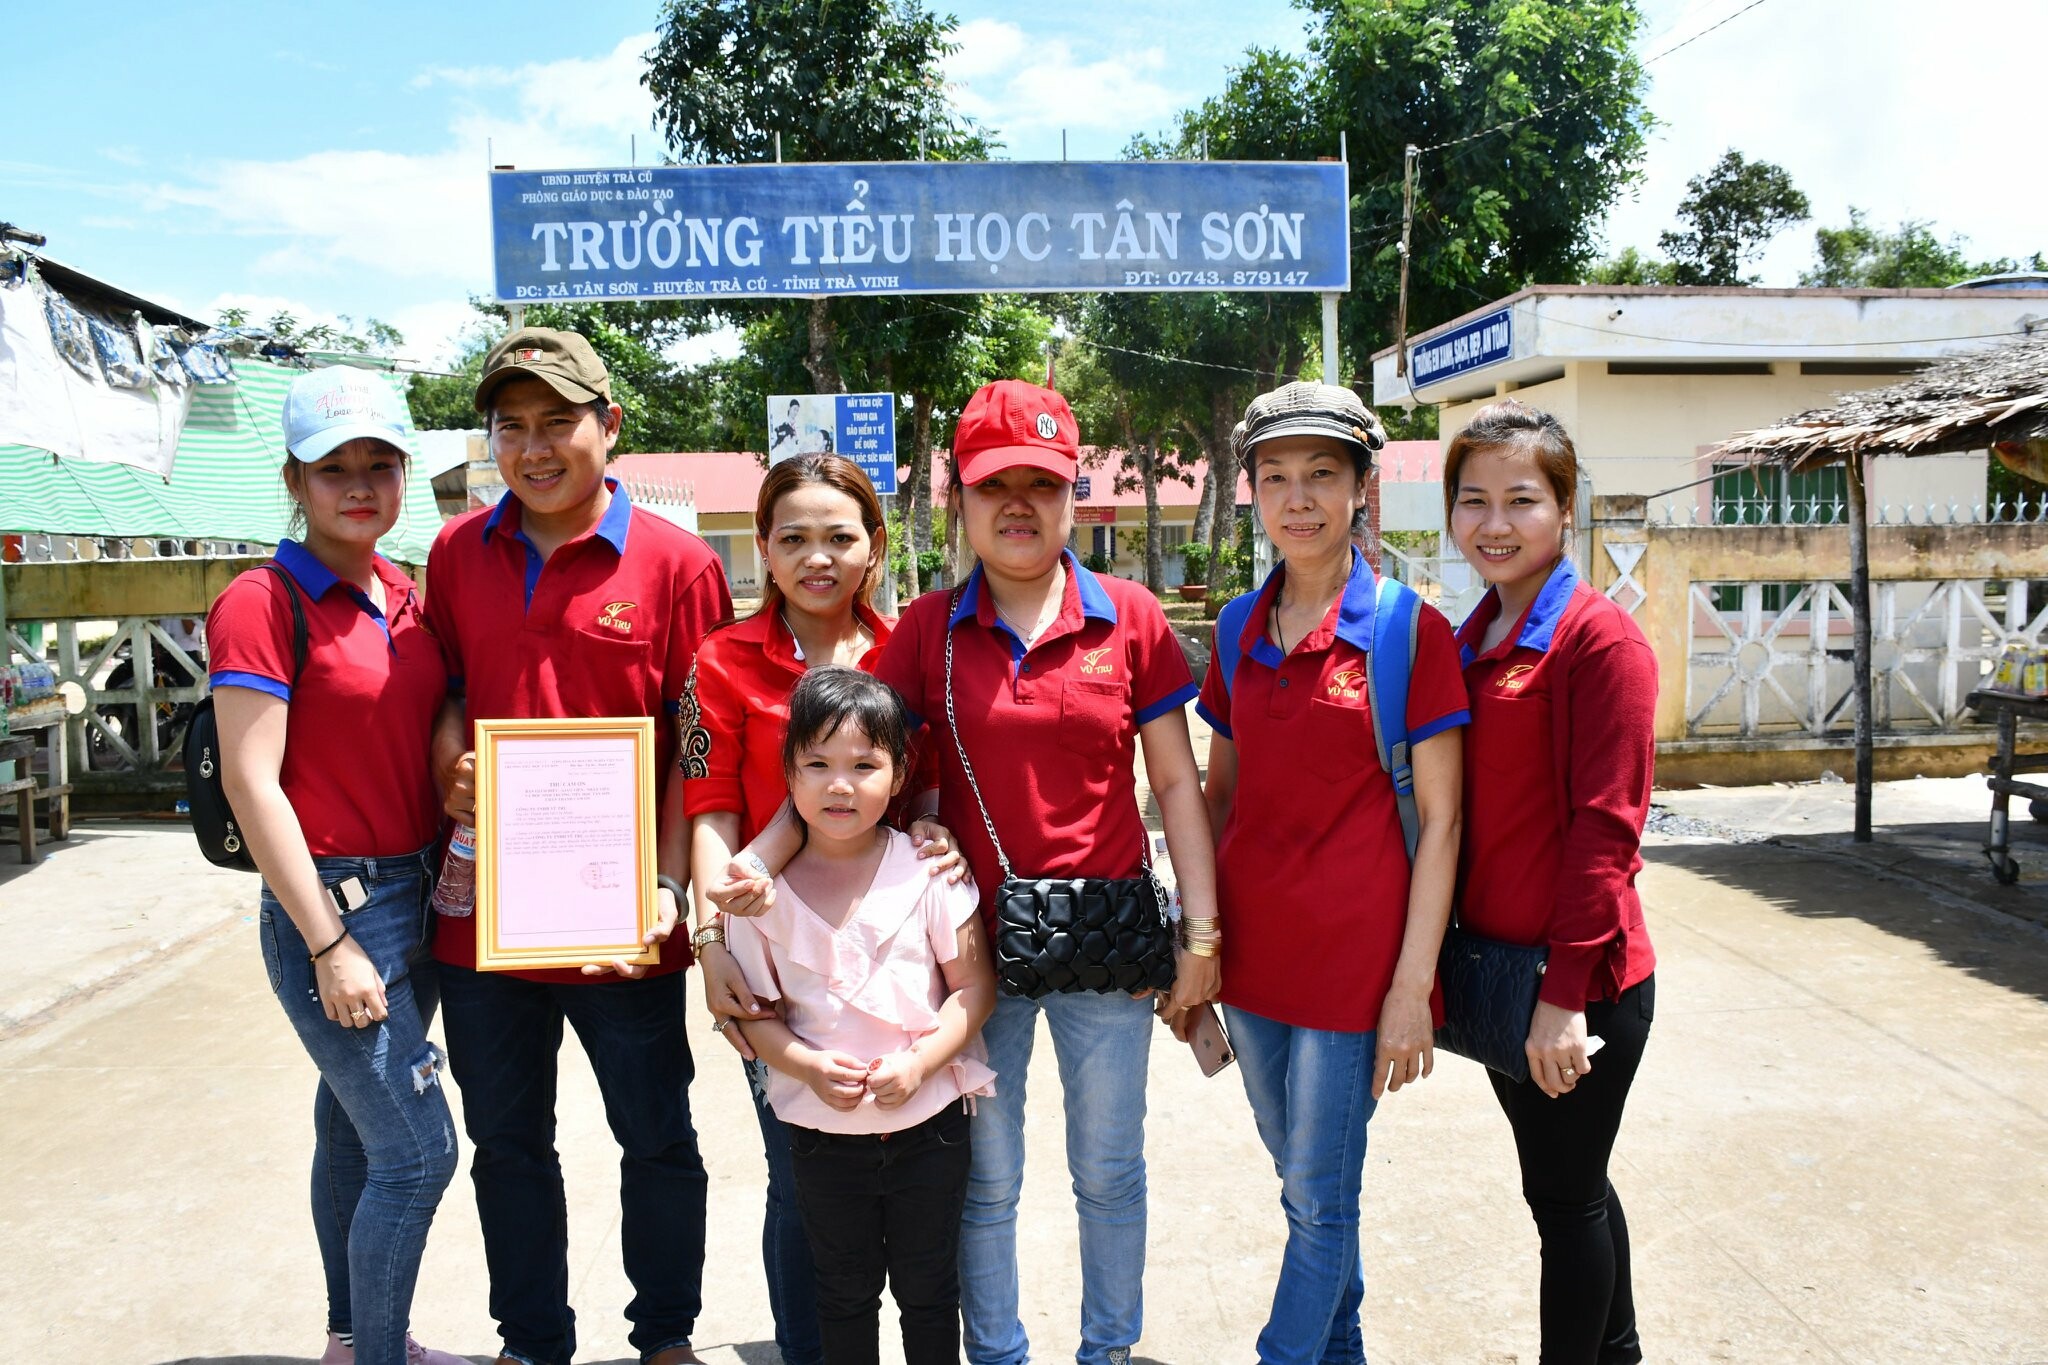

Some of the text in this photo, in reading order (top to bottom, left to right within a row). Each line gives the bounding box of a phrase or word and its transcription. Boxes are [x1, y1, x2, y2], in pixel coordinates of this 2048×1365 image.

[542, 175, 570, 186] UBND
[573, 173, 610, 186] HUYỆN
[613, 171, 635, 183] TRÀ
[522, 188, 674, 203] PHÒNG GIÁO DỤC & ĐÀO TẠO
[532, 180, 1305, 274] TRƯỜNG TIỂU HỌC TÂN SƠN
[516, 286, 542, 298] ĐC:
[547, 282, 569, 296] XÃ
[573, 281, 604, 295] TÂN
[609, 281, 638, 295] SƠN
[653, 278, 705, 295] HUYỆN
[710, 277, 742, 292] TRÀ
[747, 277, 768, 291] CÚ
[783, 274, 820, 290] TỈNH
[825, 275, 856, 289] TRÀ
[861, 276, 899, 288] VINH
[1125, 271, 1309, 286] ĐT: 0743. 879147
[598, 614, 632, 633] VŨ TRỤ
[1328, 685, 1341, 696] VŨ
